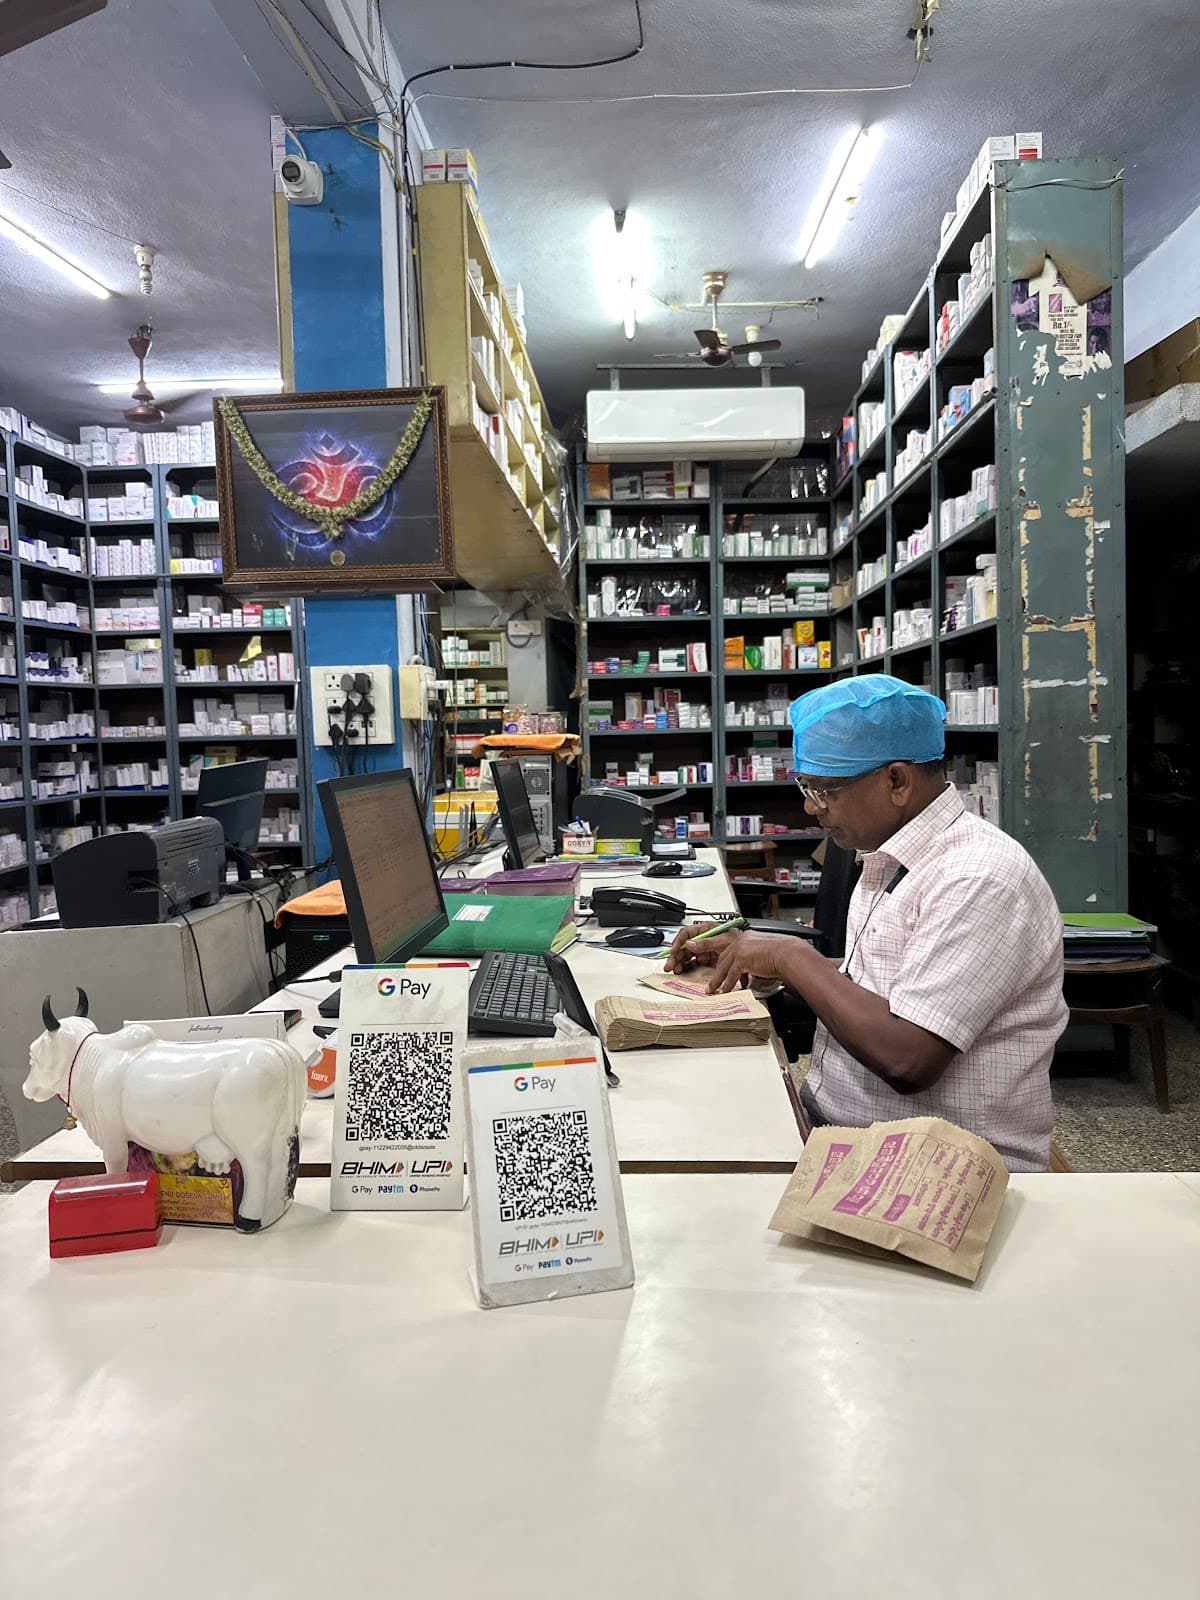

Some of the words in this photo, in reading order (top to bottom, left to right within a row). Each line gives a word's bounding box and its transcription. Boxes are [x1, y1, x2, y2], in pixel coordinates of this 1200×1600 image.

[400, 979, 432, 999] Pay
[532, 1076, 556, 1091] Pay
[341, 1162, 397, 1175] BHIM
[411, 1160, 446, 1173] UPI
[360, 1186, 372, 1195] Pay
[499, 1237, 552, 1255] BHIM
[565, 1229, 598, 1246] UPI
[523, 1264, 533, 1272] Pay
